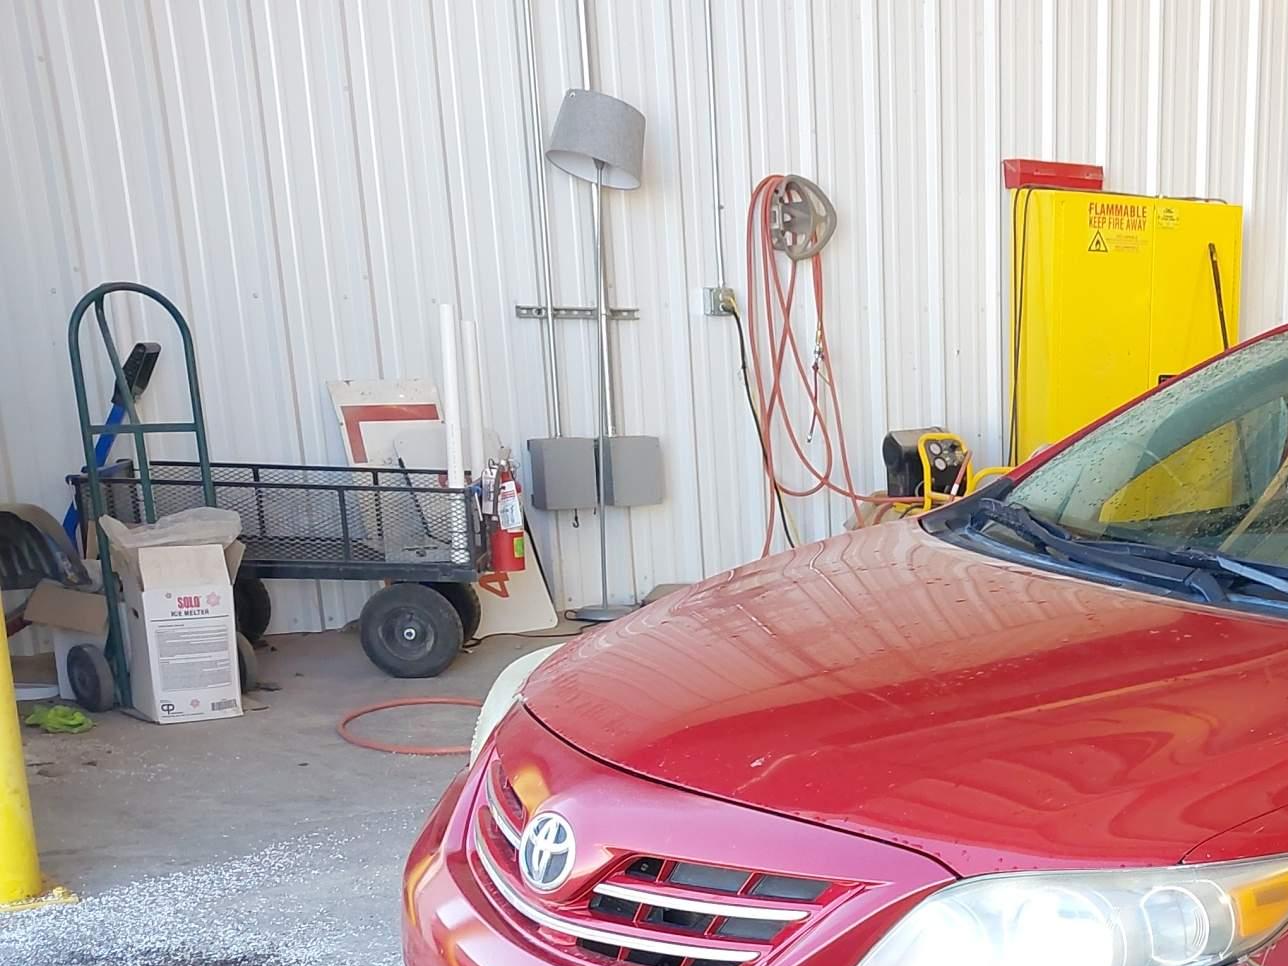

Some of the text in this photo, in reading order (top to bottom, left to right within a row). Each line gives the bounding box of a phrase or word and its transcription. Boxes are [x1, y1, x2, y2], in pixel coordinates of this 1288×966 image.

[1089, 202, 1147, 218] FLAMMABLE
[1089, 215, 1107, 229] KEEP
[1108, 217, 1124, 230] FIRE
[1125, 218, 1146, 232] AWAY
[177, 595, 200, 609] SOLO
[184, 608, 209, 616] MELTER
